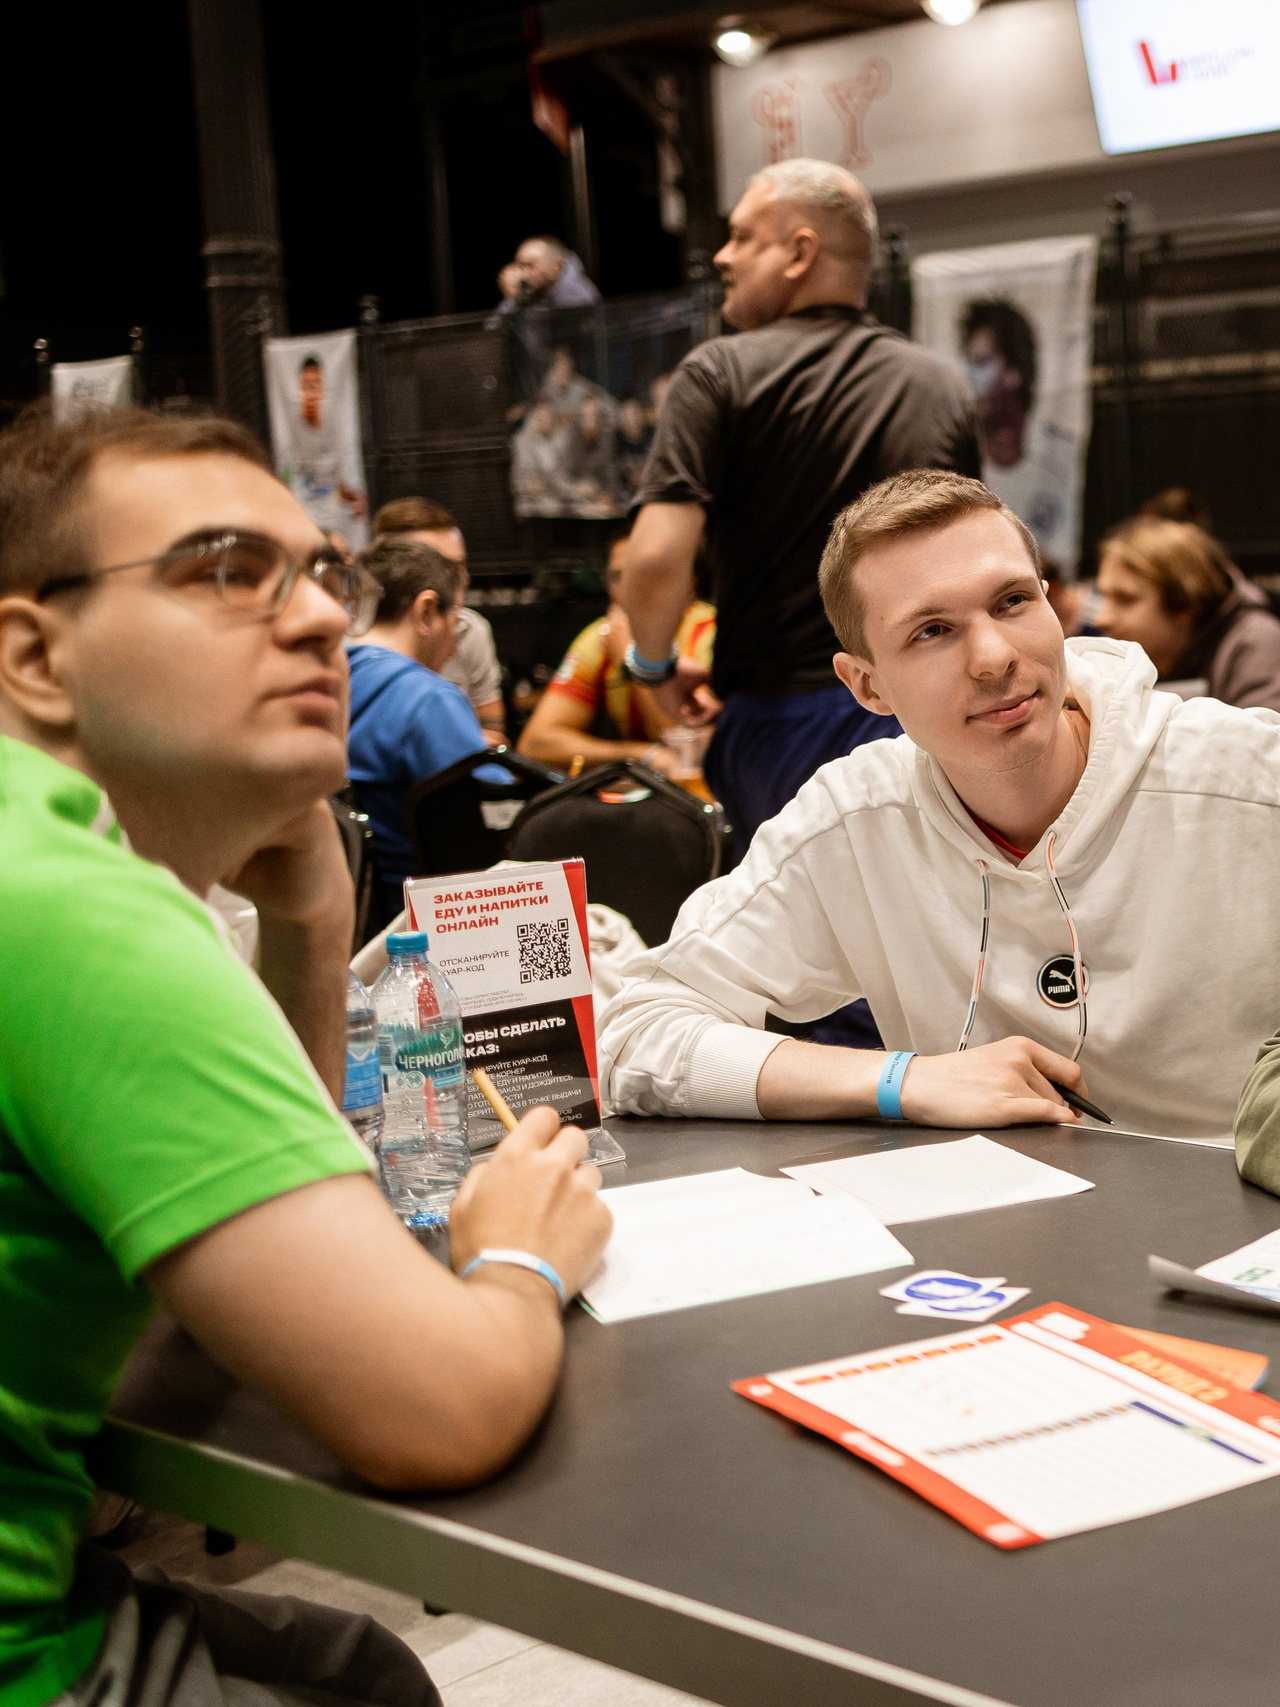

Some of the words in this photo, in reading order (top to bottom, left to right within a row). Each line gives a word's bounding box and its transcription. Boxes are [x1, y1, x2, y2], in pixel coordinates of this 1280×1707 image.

[433, 881, 544, 904] ЗАКАЗЫВАЙТЕ
[434, 906, 464, 919] ЕДУ
[467, 905, 477, 915] И
[480, 895, 549, 913] НАПИТКИ
[435, 915, 499, 934] ОНЛАЙН
[439, 950, 510, 967] ОТСКАНИРУЙТЕ
[1047, 984, 1071, 994] PUMA
[462, 1028, 499, 1043] ОБЫ
[500, 1017, 566, 1037] СДЕЛАТЬ
[464, 1043, 500, 1058] КАЗ:
[512, 1054, 548, 1067] КУАР-КОД
[496, 1067, 526, 1078] КОРНЕР
[496, 1079, 512, 1087] ЕДУ
[518, 1070, 553, 1082] НАПИТКИ
[498, 1084, 521, 1095] ЗАКАЗ
[528, 1075, 574, 1090] ДОЖДИТЕСЬ
[528, 1095, 550, 1105] ТОЧКЕ
[551, 1089, 582, 1101] ВЫДАЧИ
